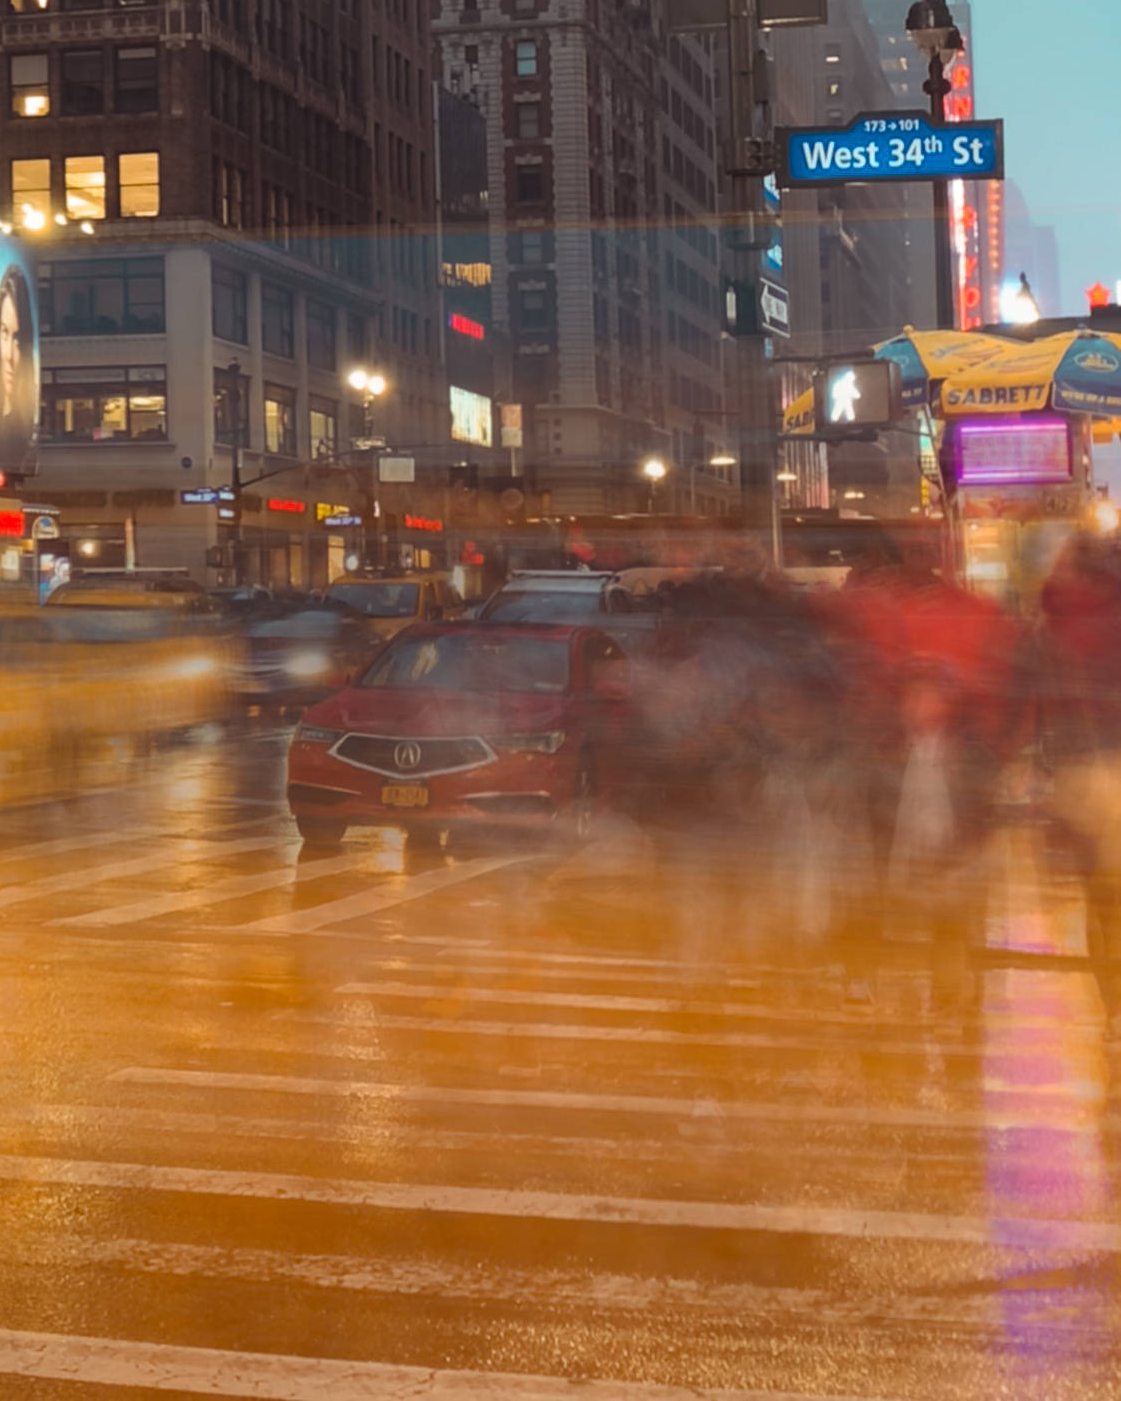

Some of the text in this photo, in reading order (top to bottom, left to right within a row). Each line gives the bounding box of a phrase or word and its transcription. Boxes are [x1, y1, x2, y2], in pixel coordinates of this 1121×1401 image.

[864, 119, 920, 132] 173 101
[802, 135, 984, 170] West 34th St
[947, 383, 1046, 406] SABRETT
